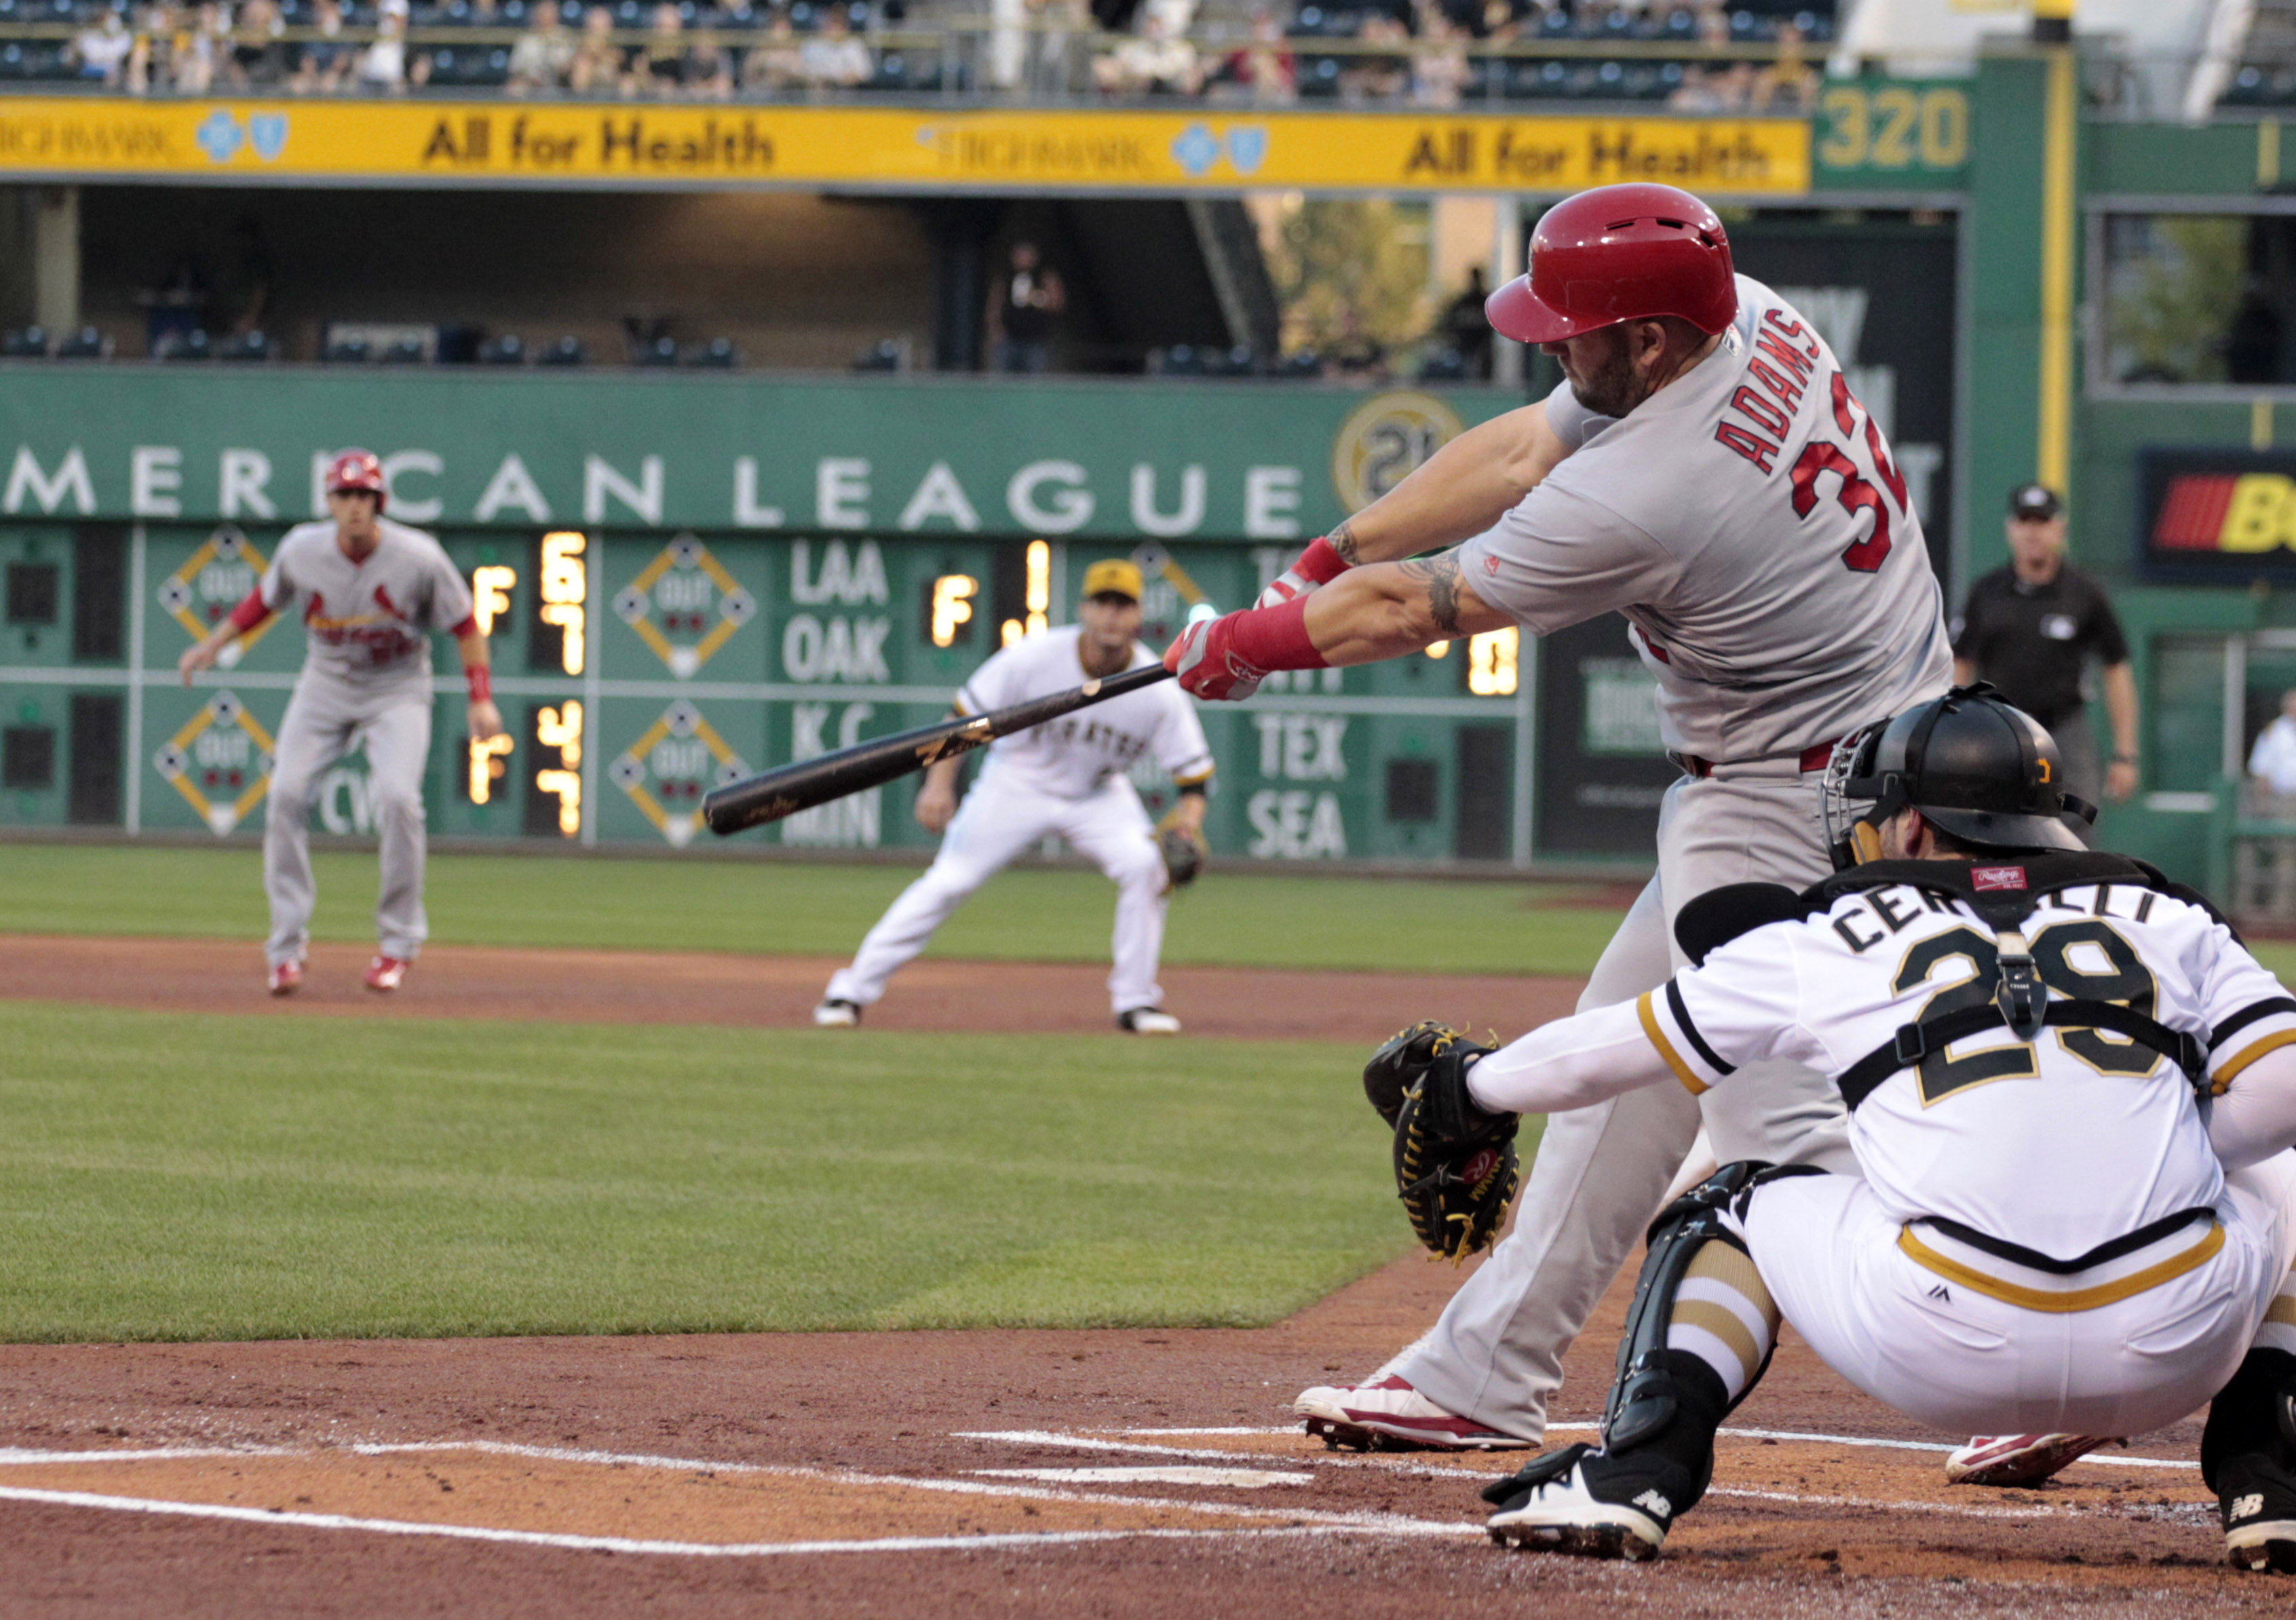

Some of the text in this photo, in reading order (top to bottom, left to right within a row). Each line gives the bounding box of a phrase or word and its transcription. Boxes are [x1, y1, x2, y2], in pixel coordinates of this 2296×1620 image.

[422, 114, 778, 170] All for Health
[1402, 129, 1476, 176] All
[1497, 129, 1569, 178] for
[1821, 87, 1968, 168] 320
[1714, 308, 1821, 476] ADAMS
[733, 453, 1304, 540] LEAGUE
[1788, 370, 1908, 574] 32
[473, 565, 517, 636] F
[789, 539, 890, 606] LAA
[932, 574, 980, 648] F
[782, 613, 892, 682] OAK
[1250, 712, 1350, 780] TEX
[1246, 788, 1349, 860] SEA
[1890, 914, 2159, 1111] 29
[2230, 1492, 2265, 1523] NB
